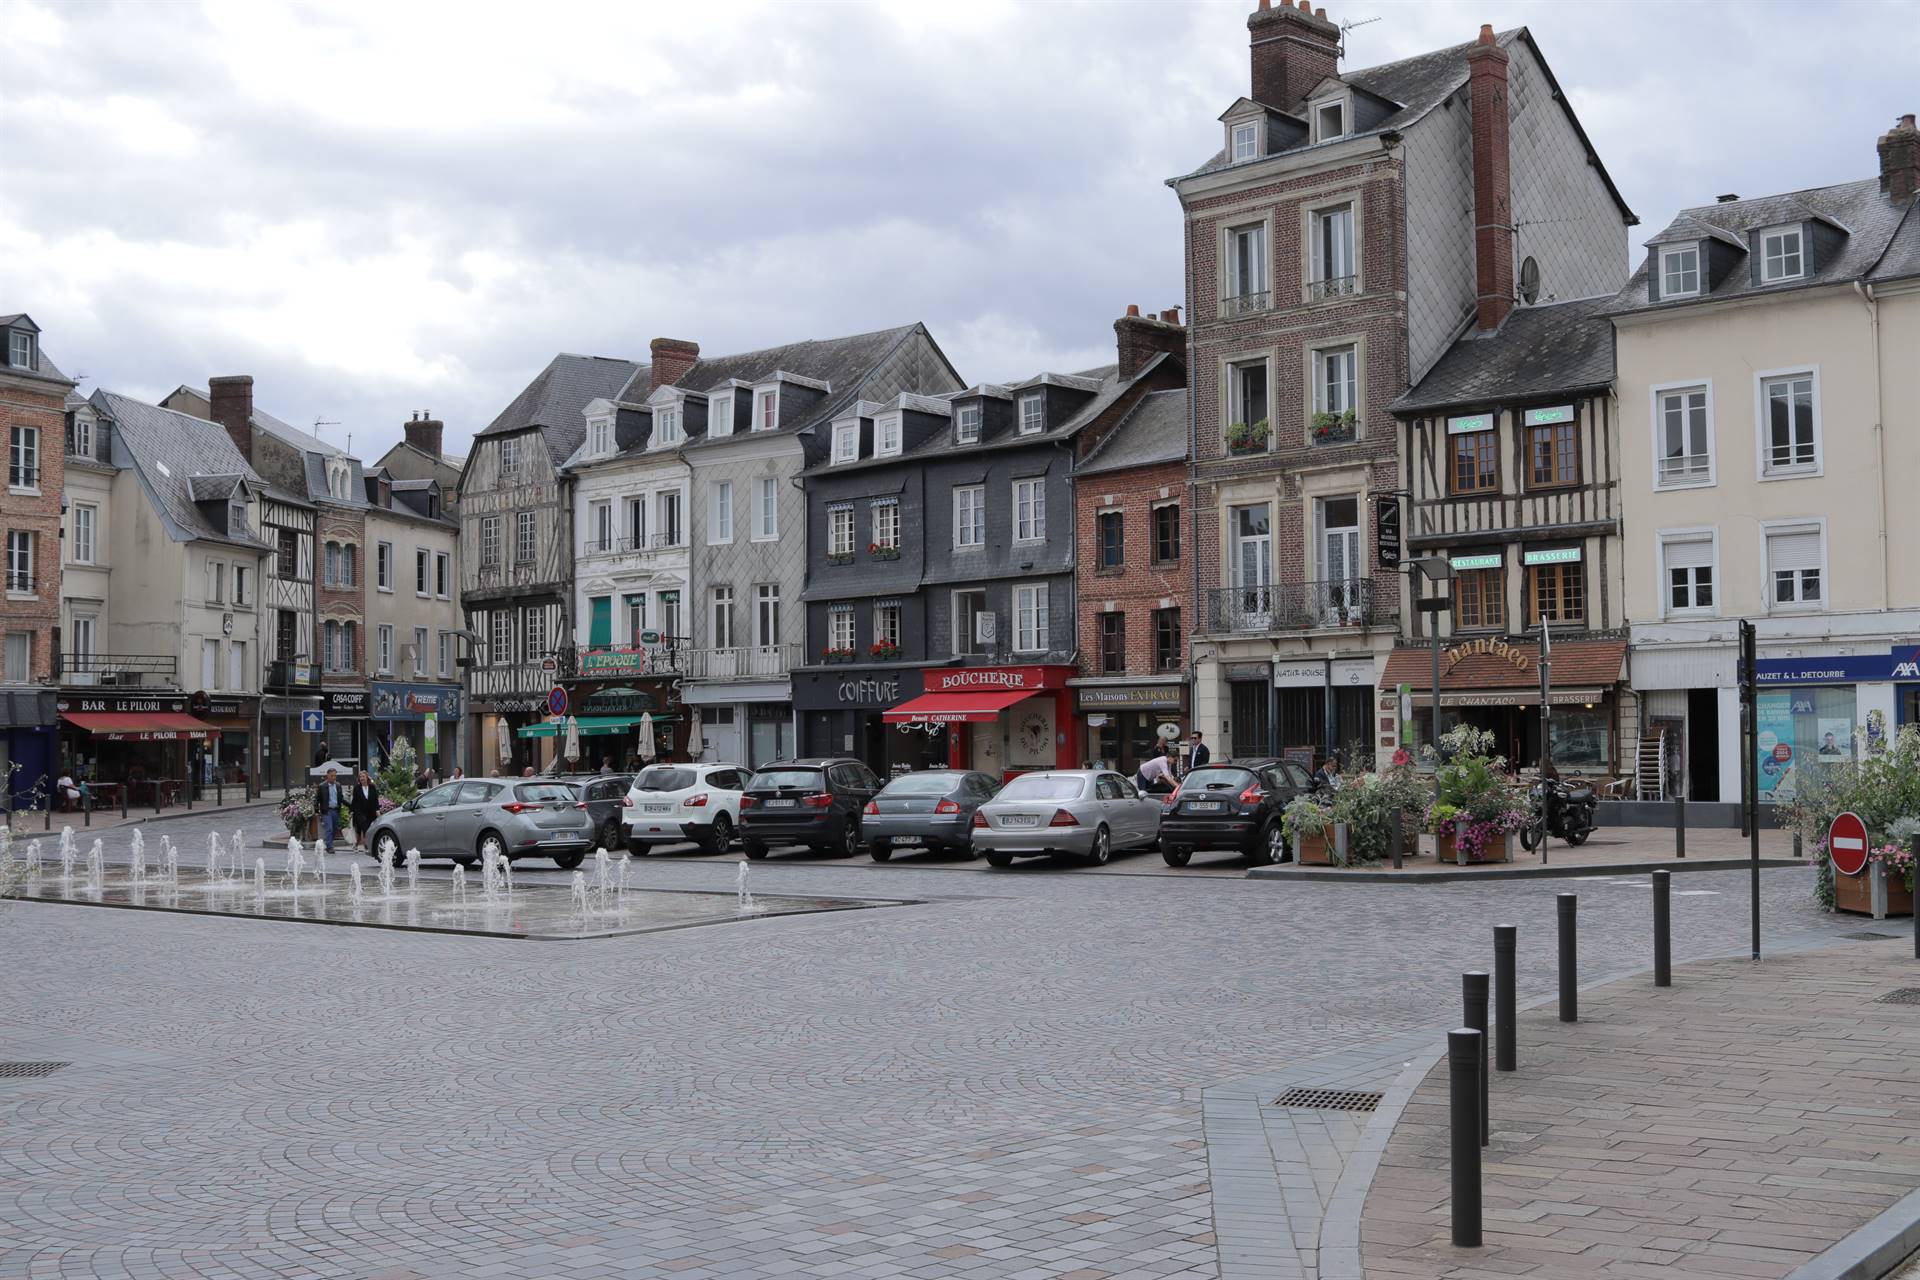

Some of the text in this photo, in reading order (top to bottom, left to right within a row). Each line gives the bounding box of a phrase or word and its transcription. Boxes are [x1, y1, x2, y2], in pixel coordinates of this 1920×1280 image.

[1453, 557, 1499, 567] RESTAURANT
[1527, 551, 1577, 562] BRASSERIE
[1800, 670, 1846, 679] DETOURBE
[1891, 662, 1920, 677] AXA
[942, 671, 1024, 689] BOUCHERIE
[838, 680, 900, 703] COIFFURE
[1080, 692, 1094, 702] Les
[1095, 691, 1128, 701] Maisons
[1553, 694, 1599, 704] BRASSERIE
[82, 700, 106, 711] BAR
[116, 701, 128, 711] LE
[130, 701, 161, 711] PILORI
[1790, 700, 1813, 713] AXA
[931, 713, 968, 722] CATHERINE
[140, 732, 150, 740] LE
[153, 731, 177, 740] PILORI
